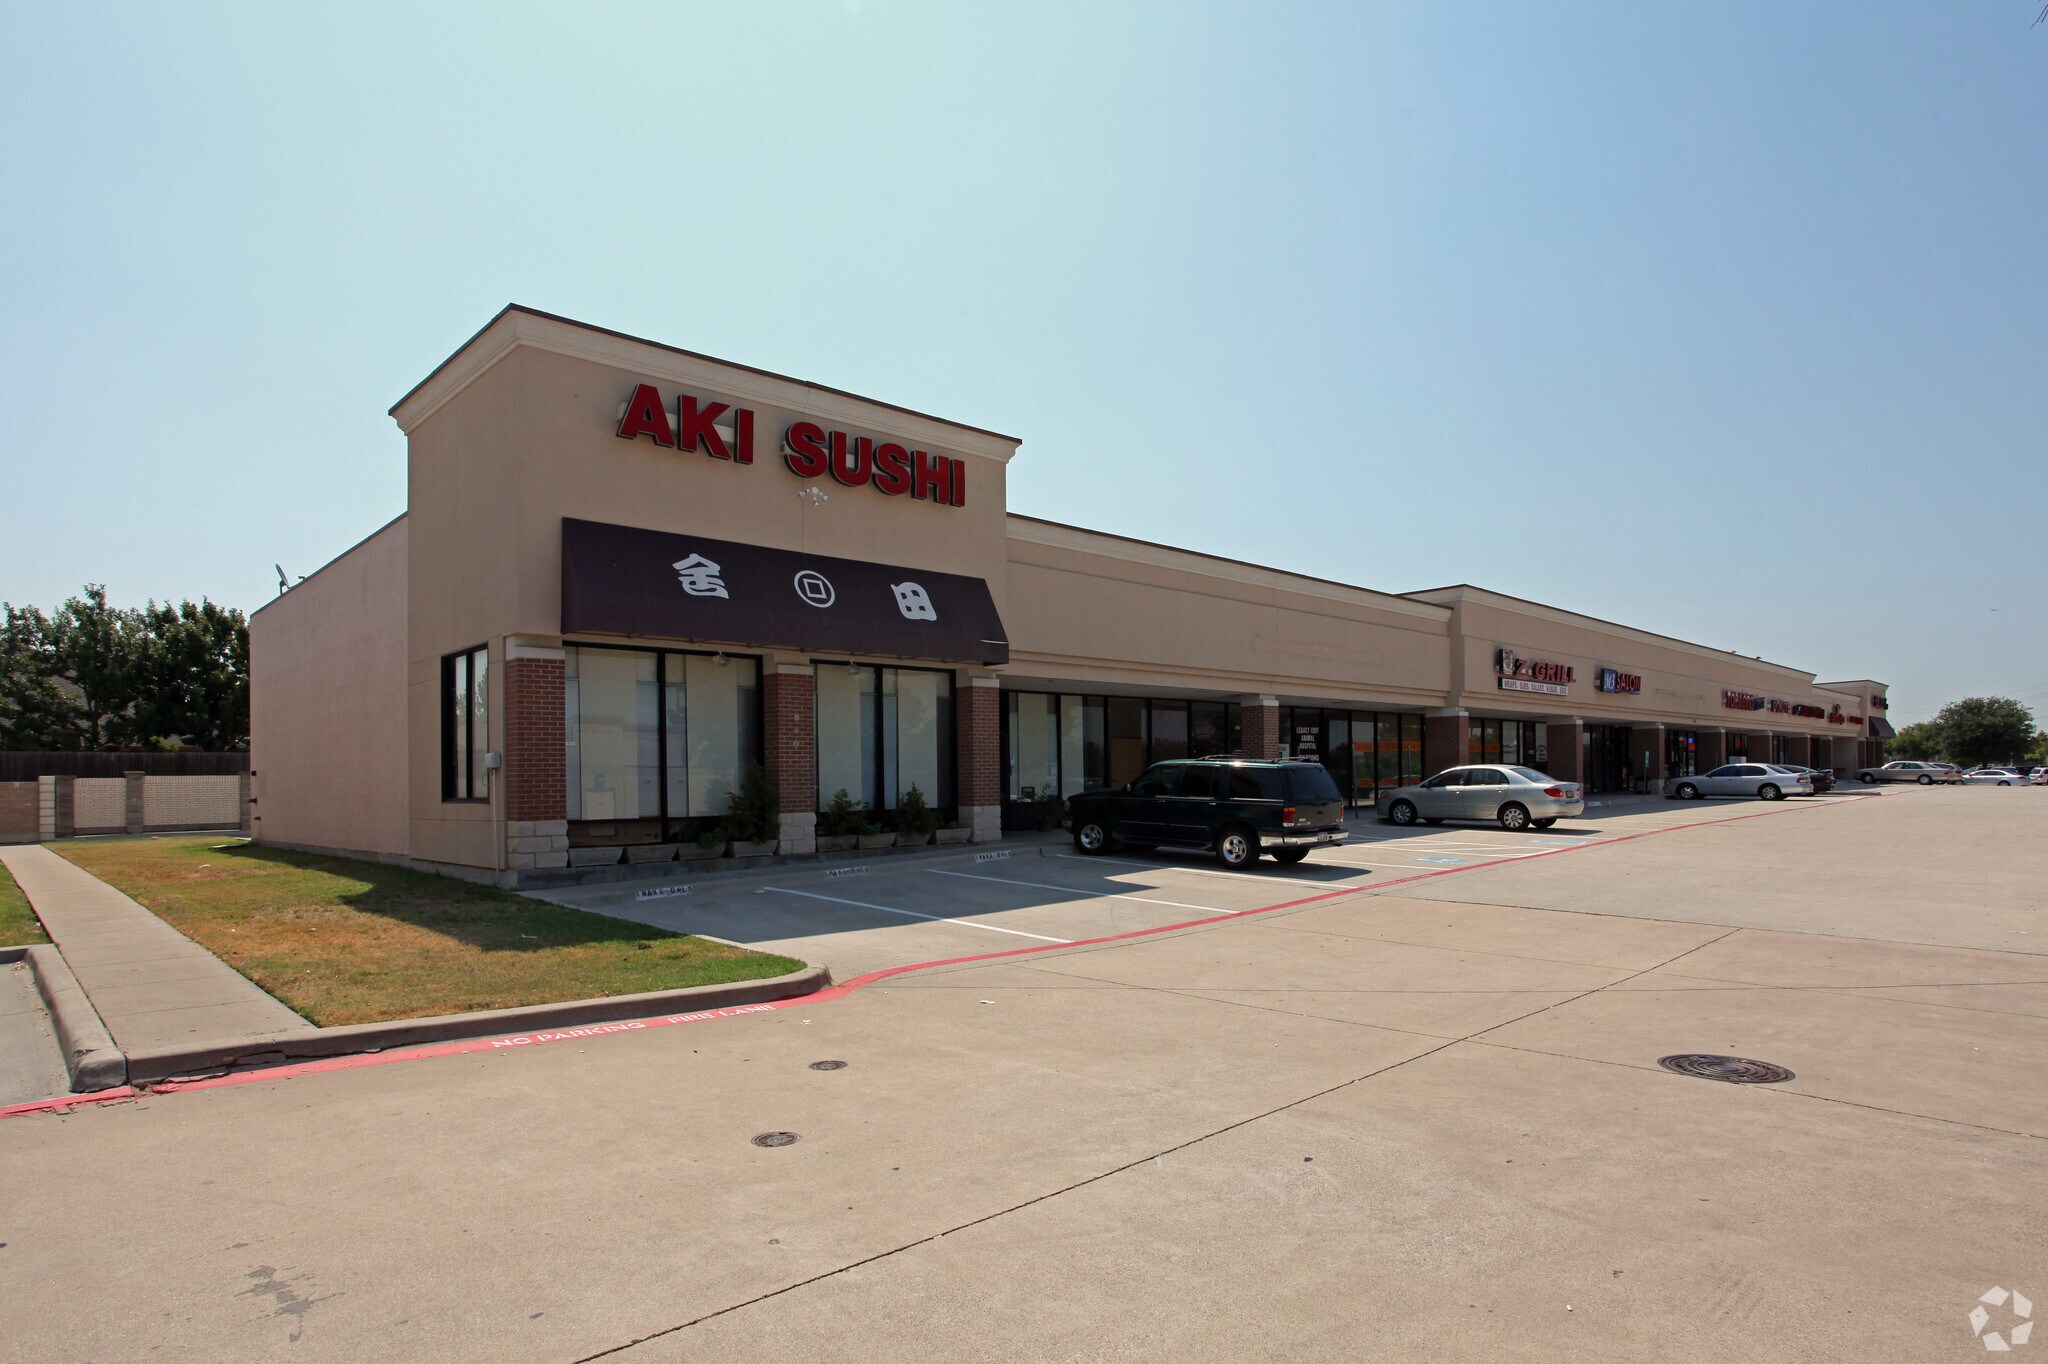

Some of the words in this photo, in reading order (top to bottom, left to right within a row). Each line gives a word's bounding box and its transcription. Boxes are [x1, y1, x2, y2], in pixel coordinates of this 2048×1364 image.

[616, 384, 754, 465] AKI
[785, 421, 966, 507] SUSHI
[1533, 662, 1577, 683] GRILL
[1616, 672, 1641, 692] SALON
[670, 884, 693, 895] ONLY
[491, 1037, 532, 1048] NO
[537, 1022, 646, 1042] PARKING
[668, 1012, 716, 1023] FIRE
[719, 1004, 776, 1017] LANE
